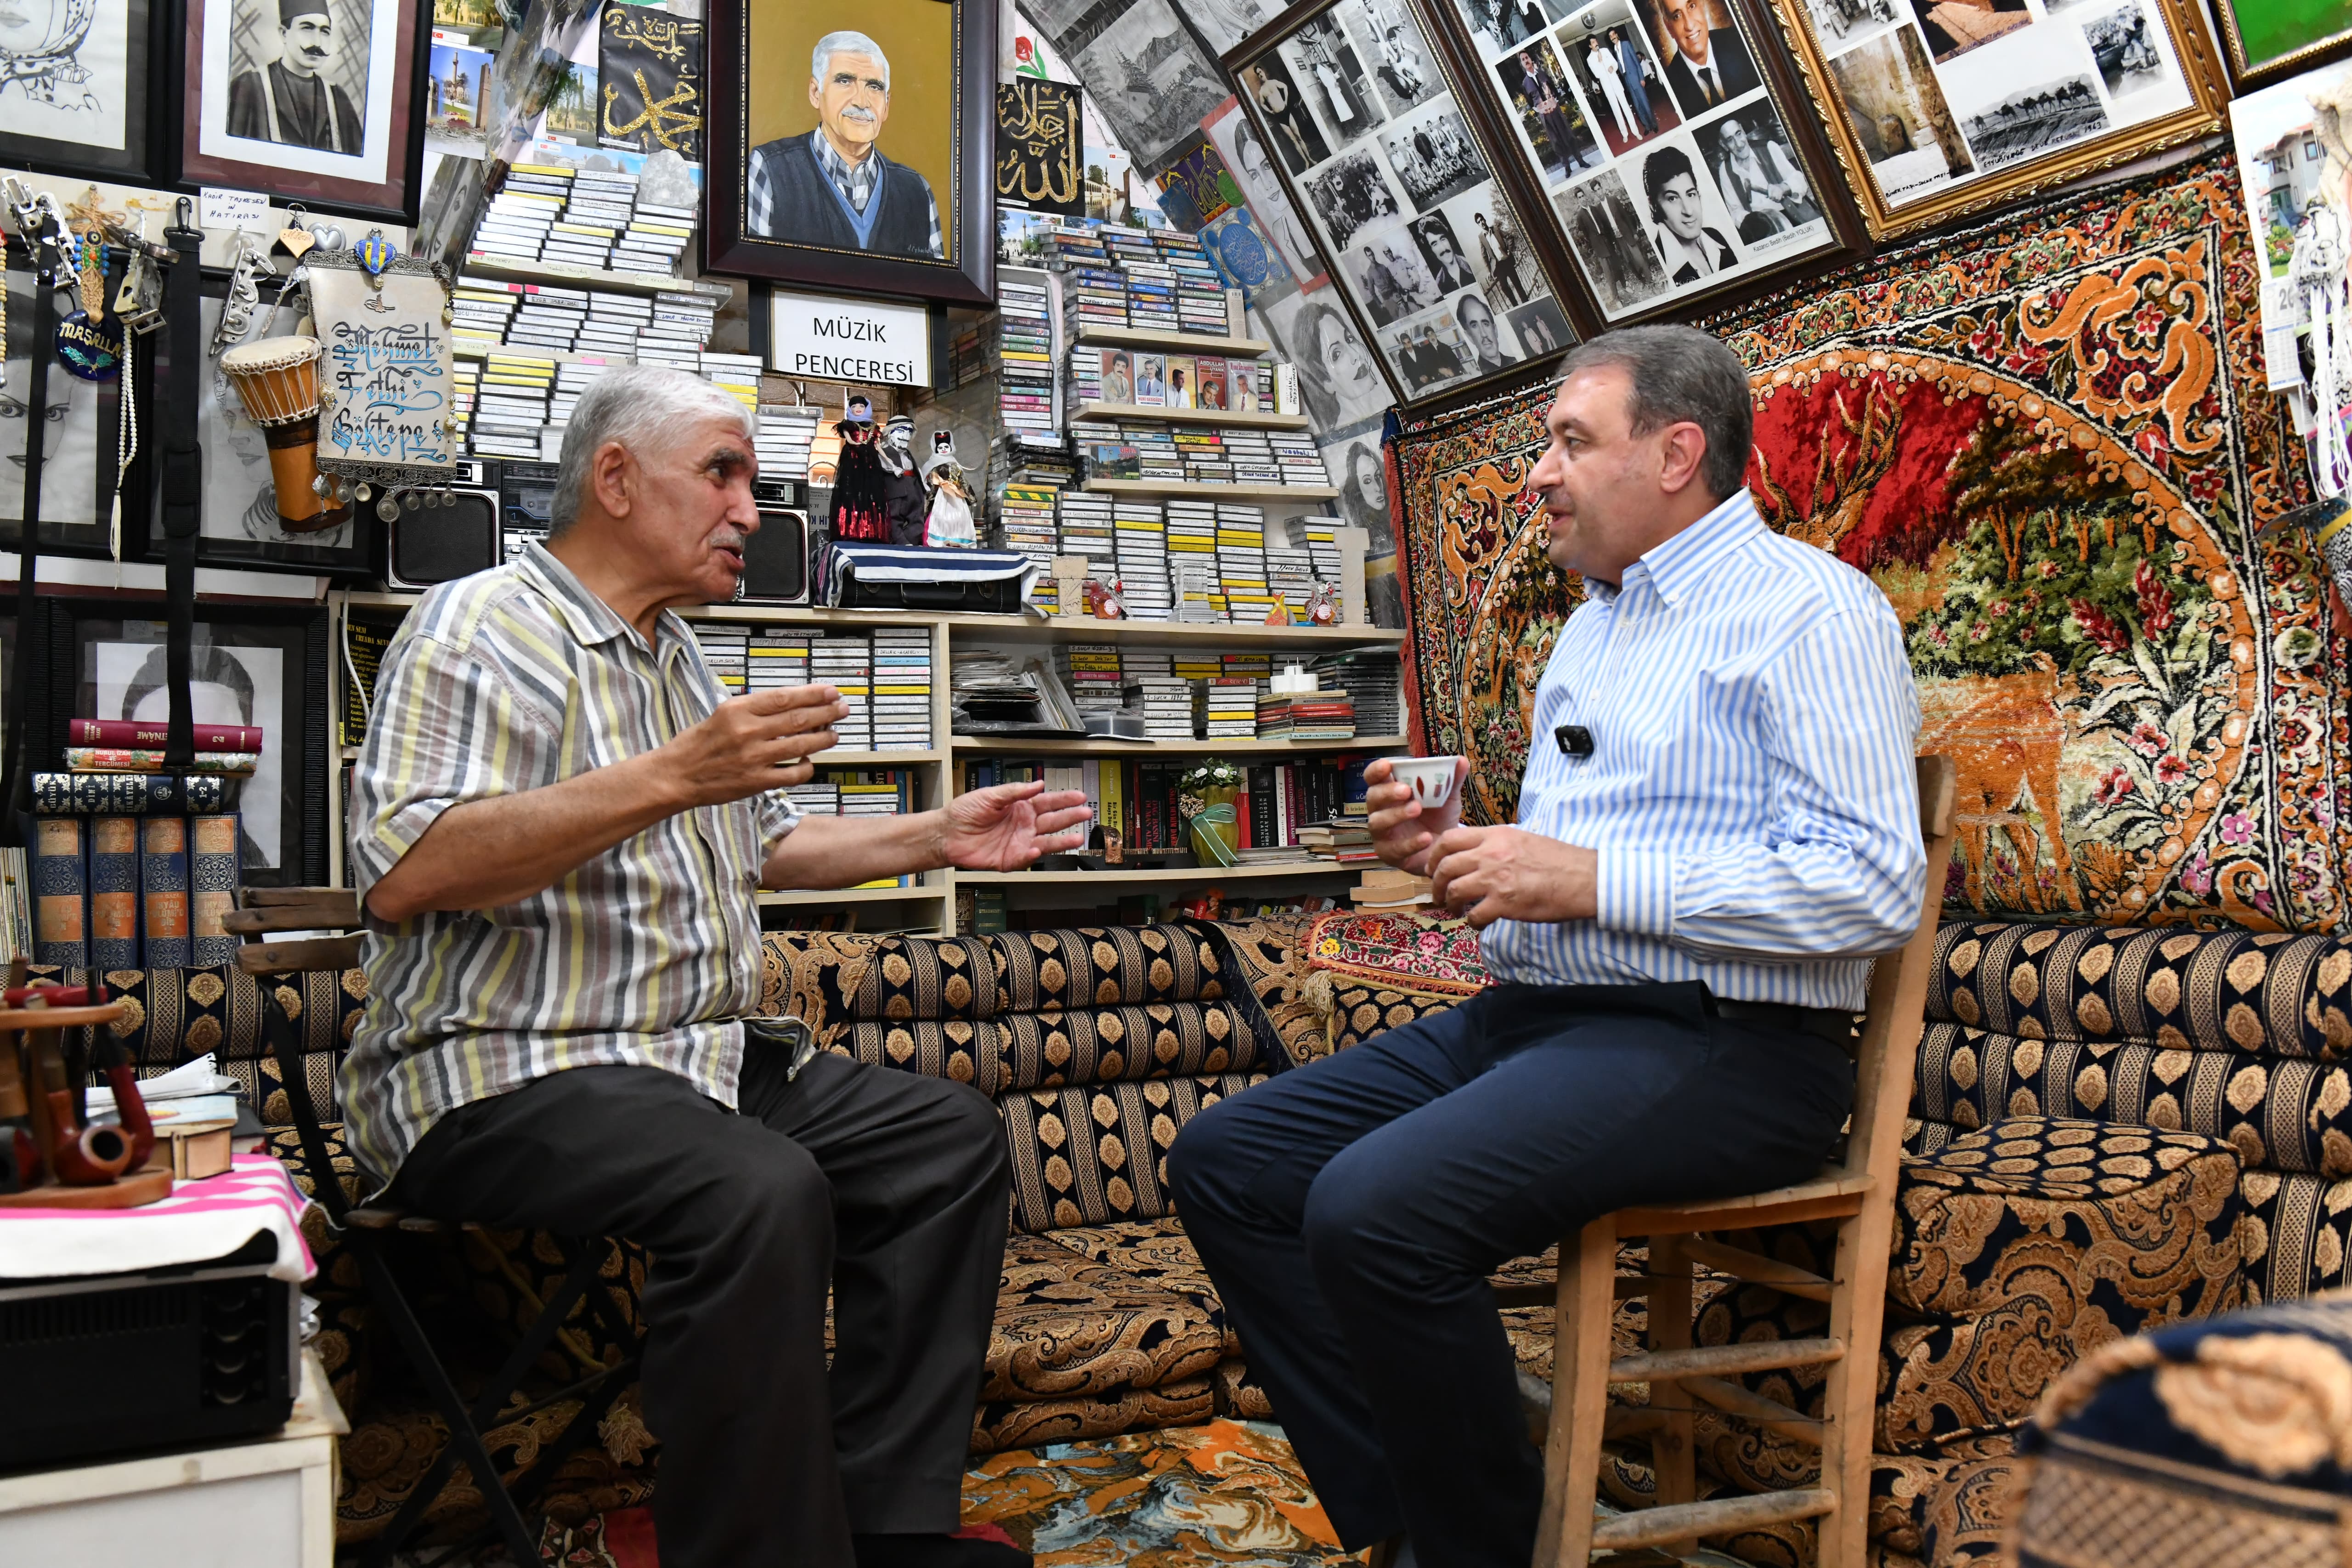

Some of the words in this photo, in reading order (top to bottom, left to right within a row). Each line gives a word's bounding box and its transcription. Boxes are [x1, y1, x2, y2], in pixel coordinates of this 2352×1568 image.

[209, 210, 259, 219] HATIRASI
[1753, 242, 1770, 252] Kazancı
[1770, 236, 1783, 246] Bedih
[1782, 232, 1797, 243] (Bedih
[1796, 225, 1815, 237] YOLUK)
[814, 316, 887, 343] MÜZİK
[796, 353, 913, 383] PENCERESİ
